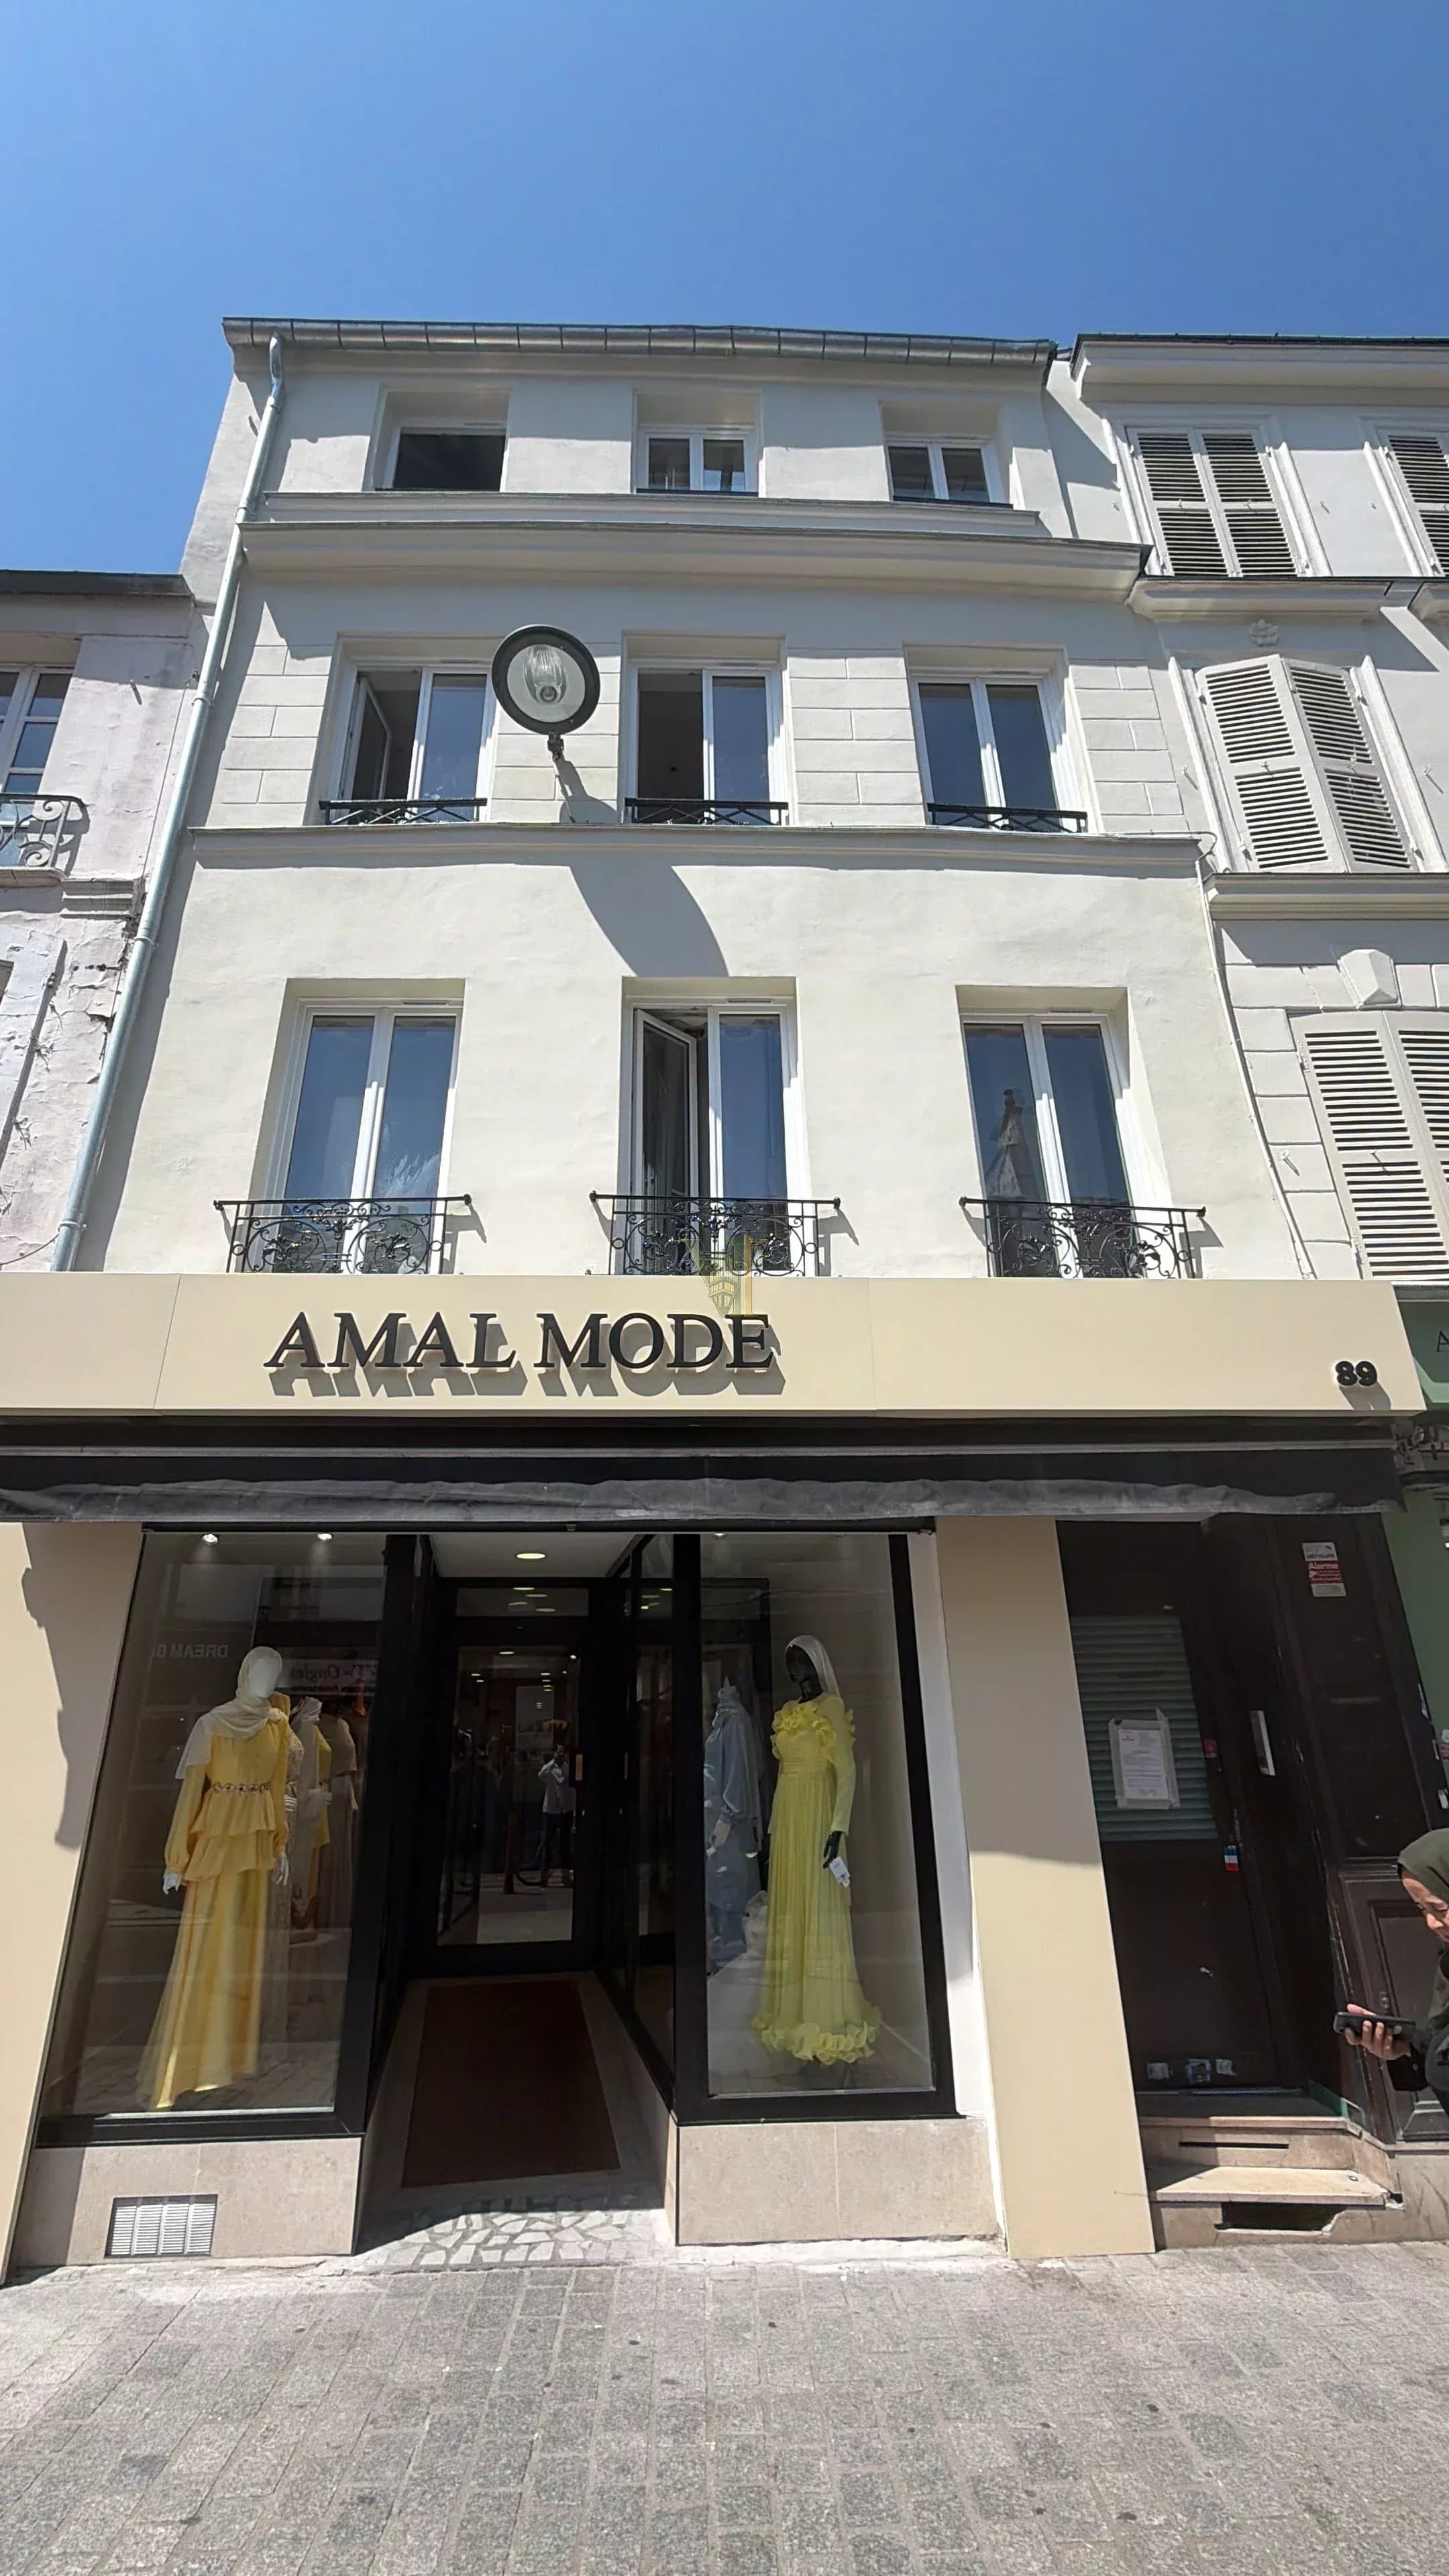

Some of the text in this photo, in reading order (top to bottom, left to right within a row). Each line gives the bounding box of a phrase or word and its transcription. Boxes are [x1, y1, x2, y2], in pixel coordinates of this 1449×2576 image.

[263, 1311, 775, 1369] AMAL MODE
[1335, 1360, 1377, 1387] 89
[1309, 1562, 1338, 1570] Alarme
